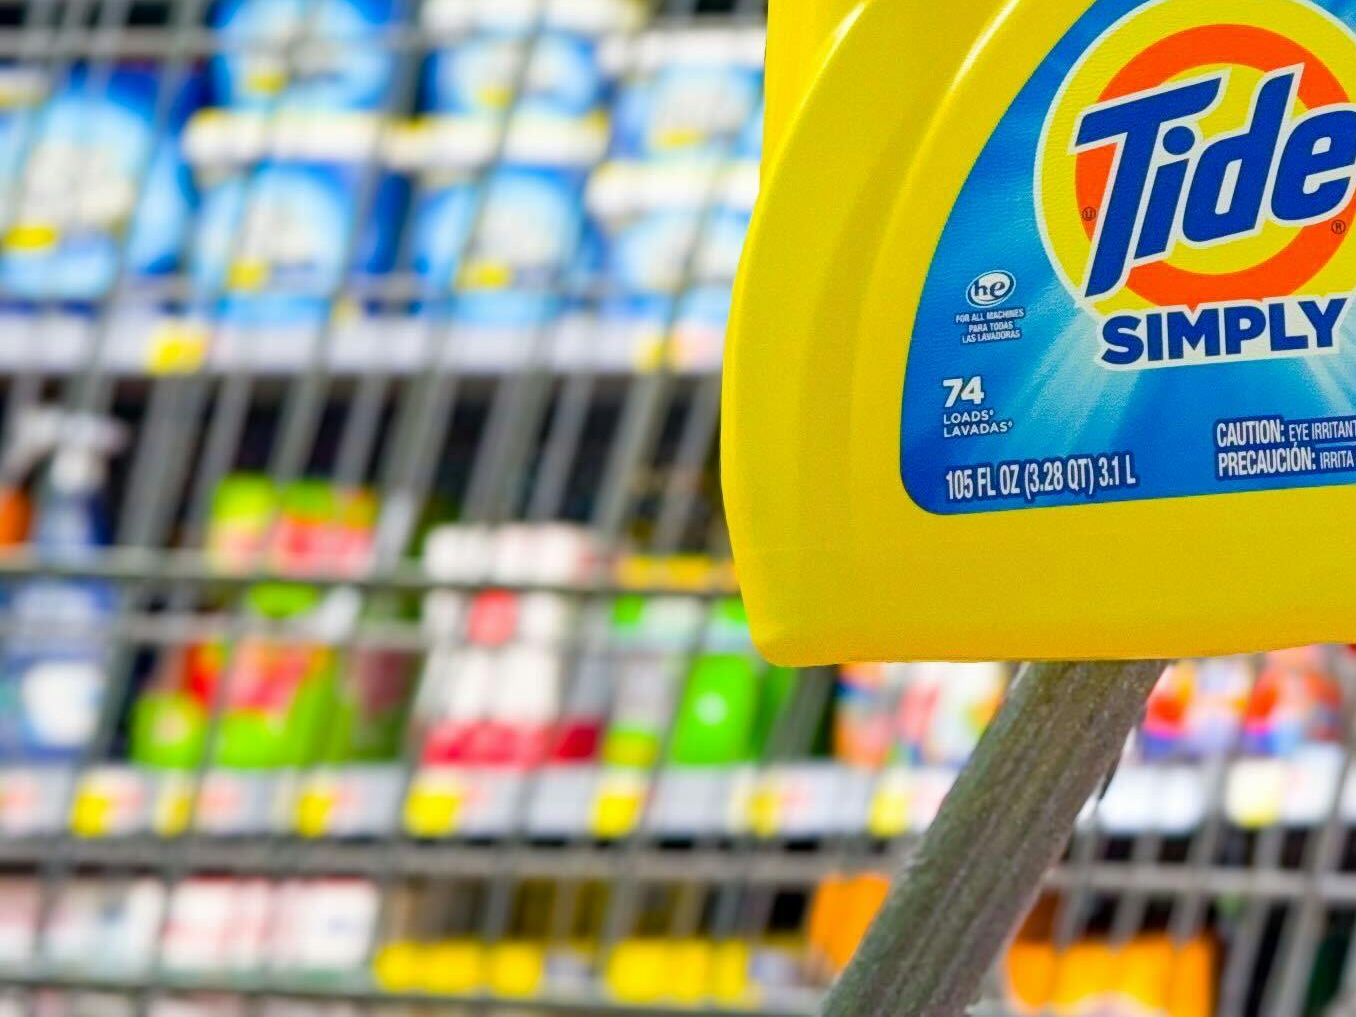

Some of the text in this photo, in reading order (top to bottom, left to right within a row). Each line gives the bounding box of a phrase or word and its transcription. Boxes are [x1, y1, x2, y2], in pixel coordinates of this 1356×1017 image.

[973, 278, 1006, 299] he
[968, 321, 1014, 333] PARA TODAS
[971, 312, 985, 322] ALL
[986, 308, 1025, 320] MACHINES
[962, 330, 1021, 343] LAS LAVADORAS
[1101, 297, 1349, 365] SIMPLY
[943, 375, 985, 408] 74
[1216, 419, 1285, 448] CAUTION:
[1289, 423, 1309, 442] EYE
[1218, 441, 1317, 477] PRECAUCIÓN:
[1320, 450, 1354, 469] IRRITA
[945, 454, 1136, 500] 105 FL OZ (3.28 QT) 3.1 L
